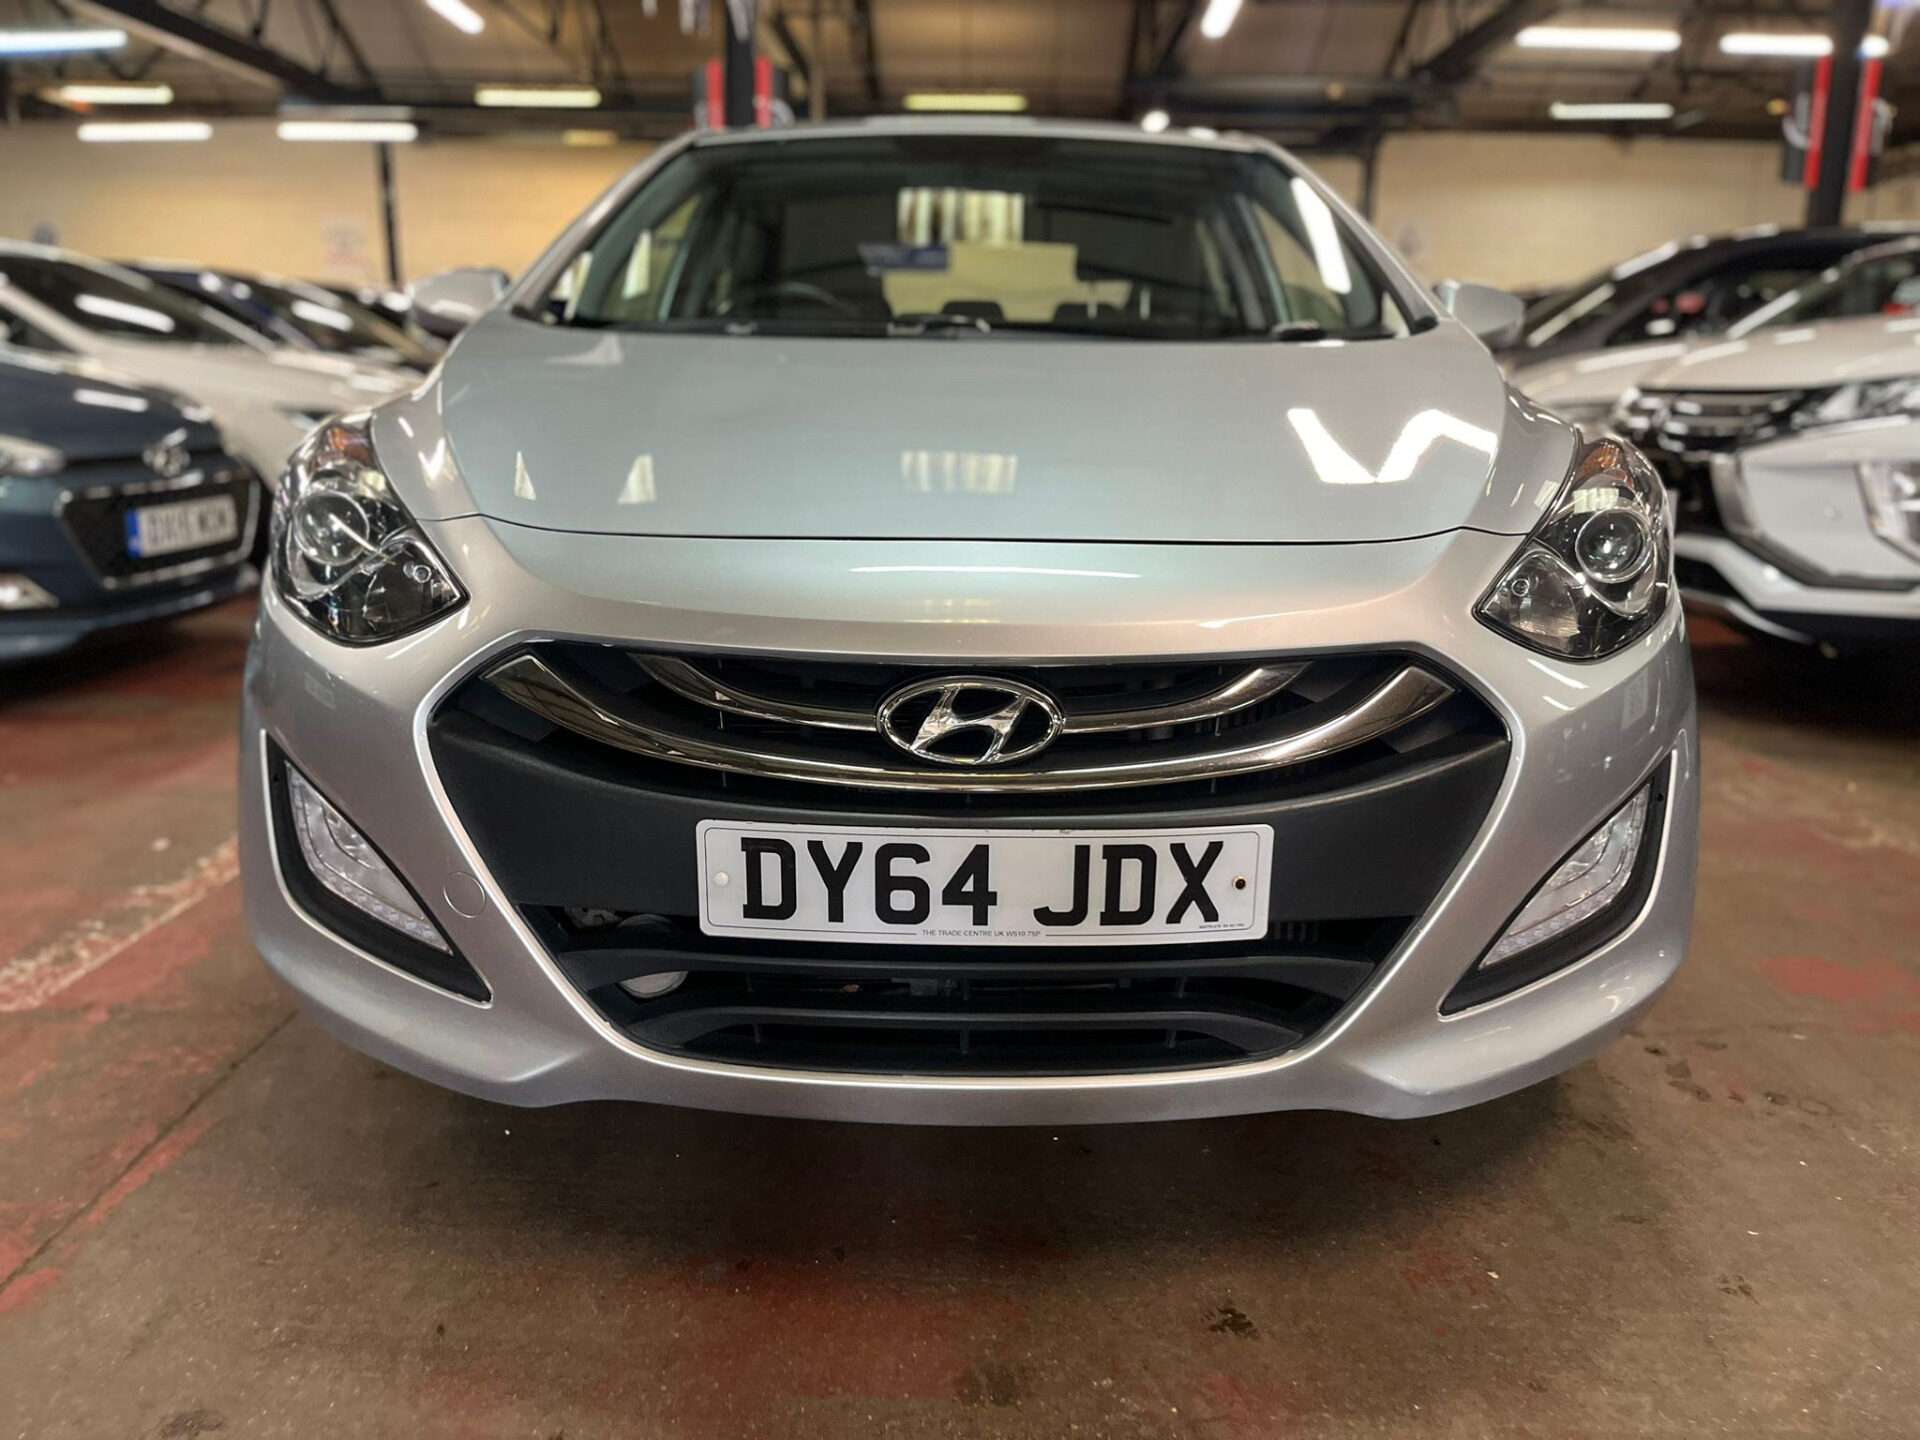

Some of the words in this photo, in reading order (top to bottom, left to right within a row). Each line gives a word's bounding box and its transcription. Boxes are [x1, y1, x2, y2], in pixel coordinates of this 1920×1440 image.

[741, 837, 998, 926] DY64
[1034, 841, 1223, 926] JDX
[922, 929, 937, 937] THE
[938, 929, 962, 937] TRADE
[963, 929, 992, 937] CENTRE
[994, 929, 1005, 937] UK
